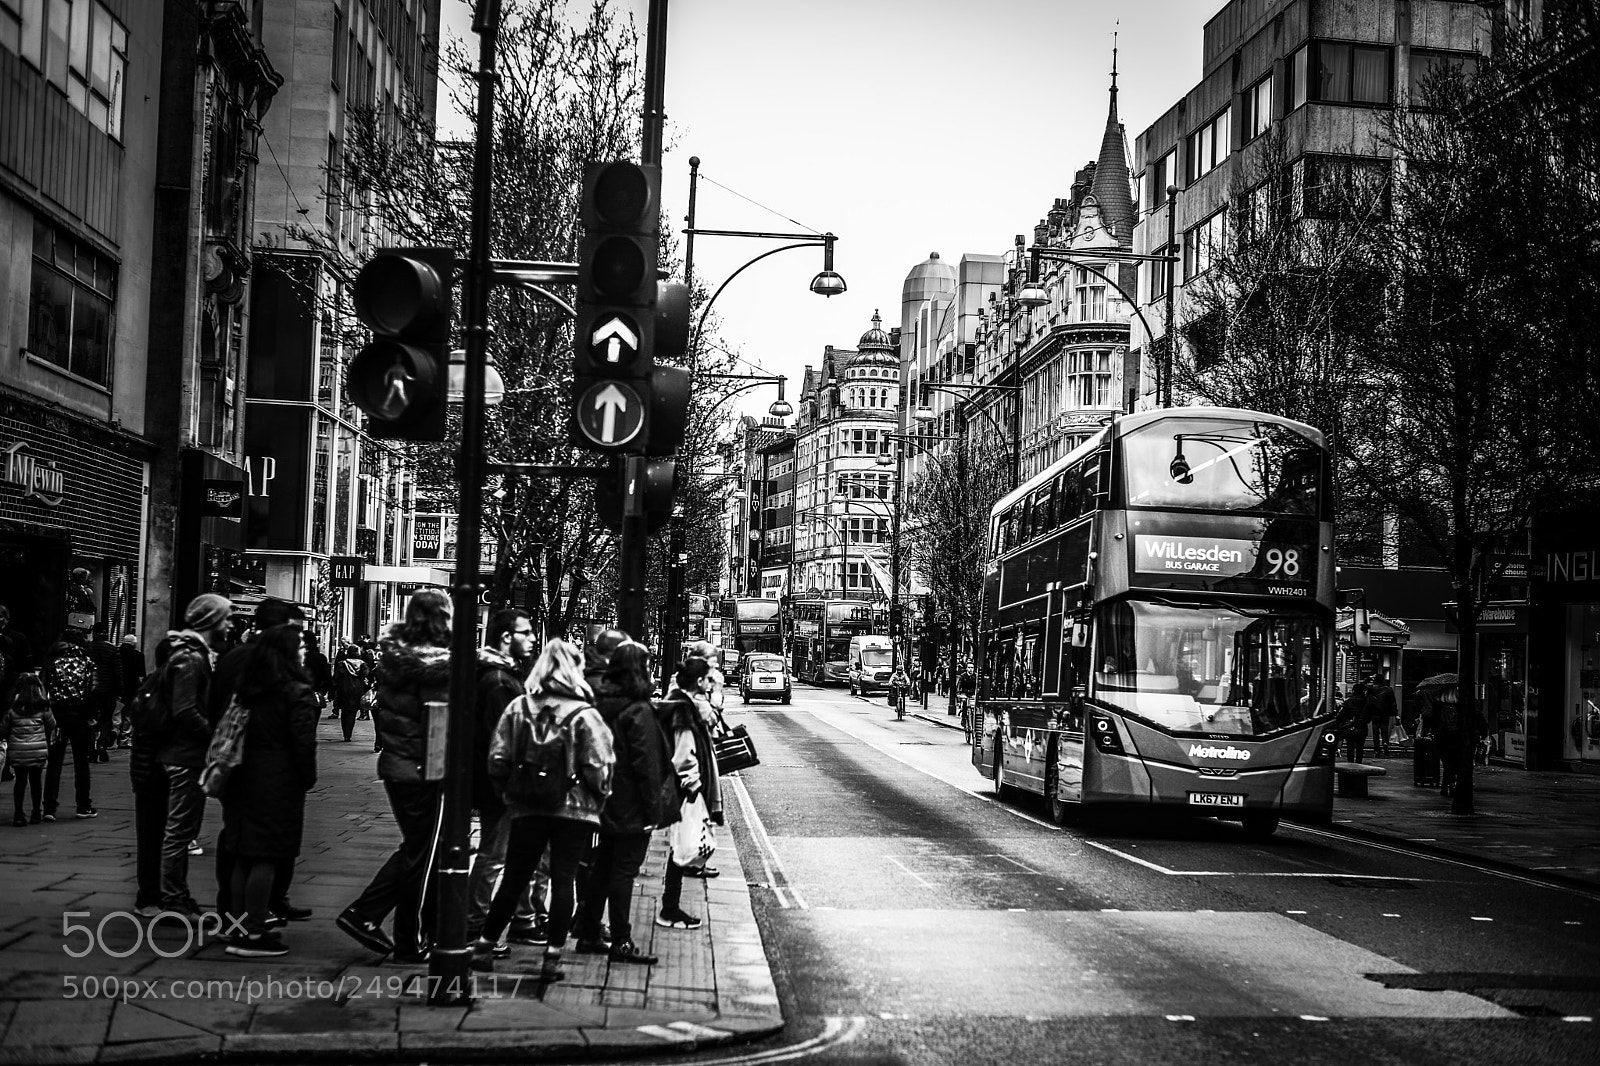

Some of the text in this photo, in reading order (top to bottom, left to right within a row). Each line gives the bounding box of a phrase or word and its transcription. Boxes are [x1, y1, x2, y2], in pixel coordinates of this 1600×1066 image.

[244, 455, 277, 497] AP
[751, 491, 760, 512] hmv
[414, 540, 440, 549] ODAY
[1144, 540, 1300, 576] Willesden 98
[1165, 561, 1220, 572] BUS GARAGE
[1547, 550, 1600, 582] INGL
[335, 564, 356, 580] GAP
[750, 558, 758, 578] hmv
[1267, 586, 1307, 597] VWH2401
[1188, 744, 1251, 761] Metroline
[1193, 794, 1240, 805] LK67 ENJ
